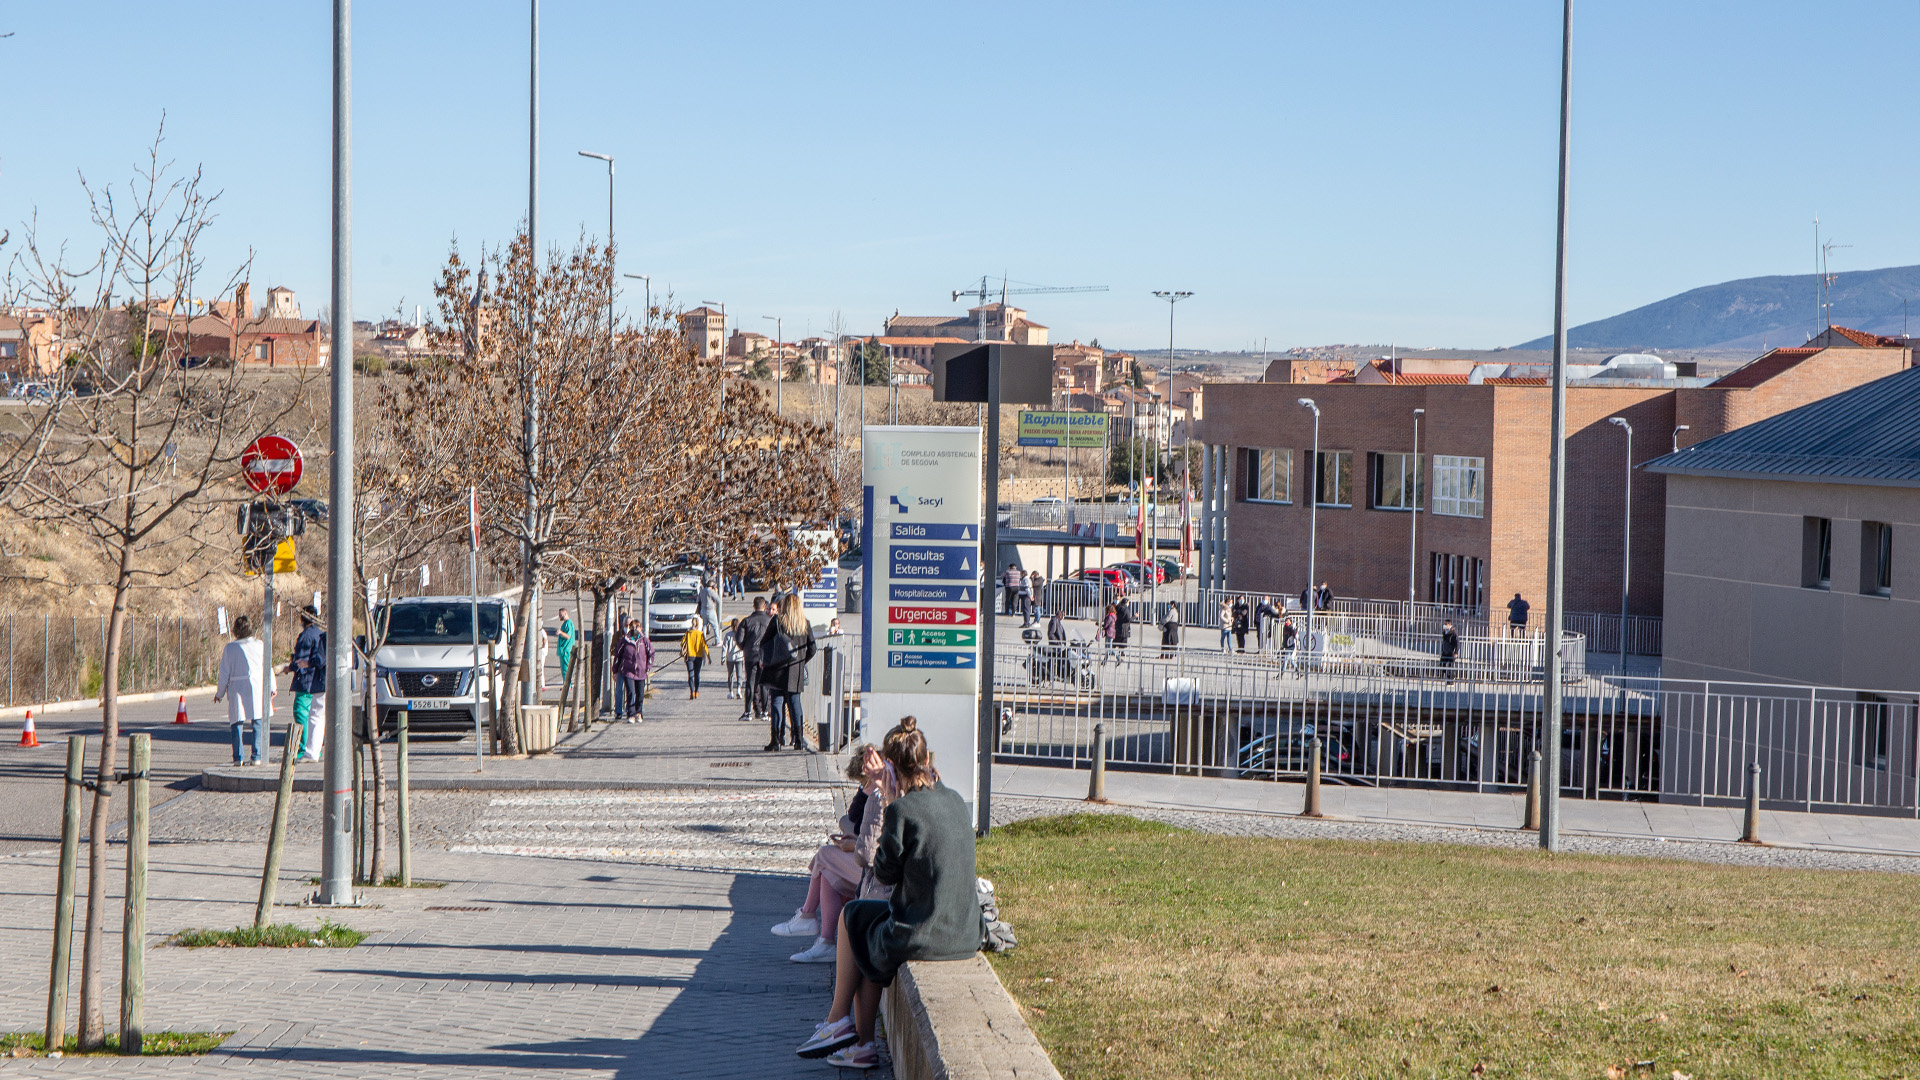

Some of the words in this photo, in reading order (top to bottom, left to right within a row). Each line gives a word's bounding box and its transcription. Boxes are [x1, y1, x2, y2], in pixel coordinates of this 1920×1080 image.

[1023, 413, 1104, 427] Rapimueble
[901, 450, 936, 458] COMPLEJO
[936, 451, 977, 459] ASISTENCIAL
[911, 459, 939, 467] SEGOVIA
[918, 496, 944, 508] Sacyl
[895, 525, 926, 536] Salida
[895, 550, 945, 561] Consultas
[895, 563, 940, 575] Externas
[894, 588, 947, 599] Hospitalización
[895, 607, 948, 622] Urgencias
[894, 632, 902, 642] P
[921, 637, 947, 645] Pking
[893, 654, 901, 664] P
